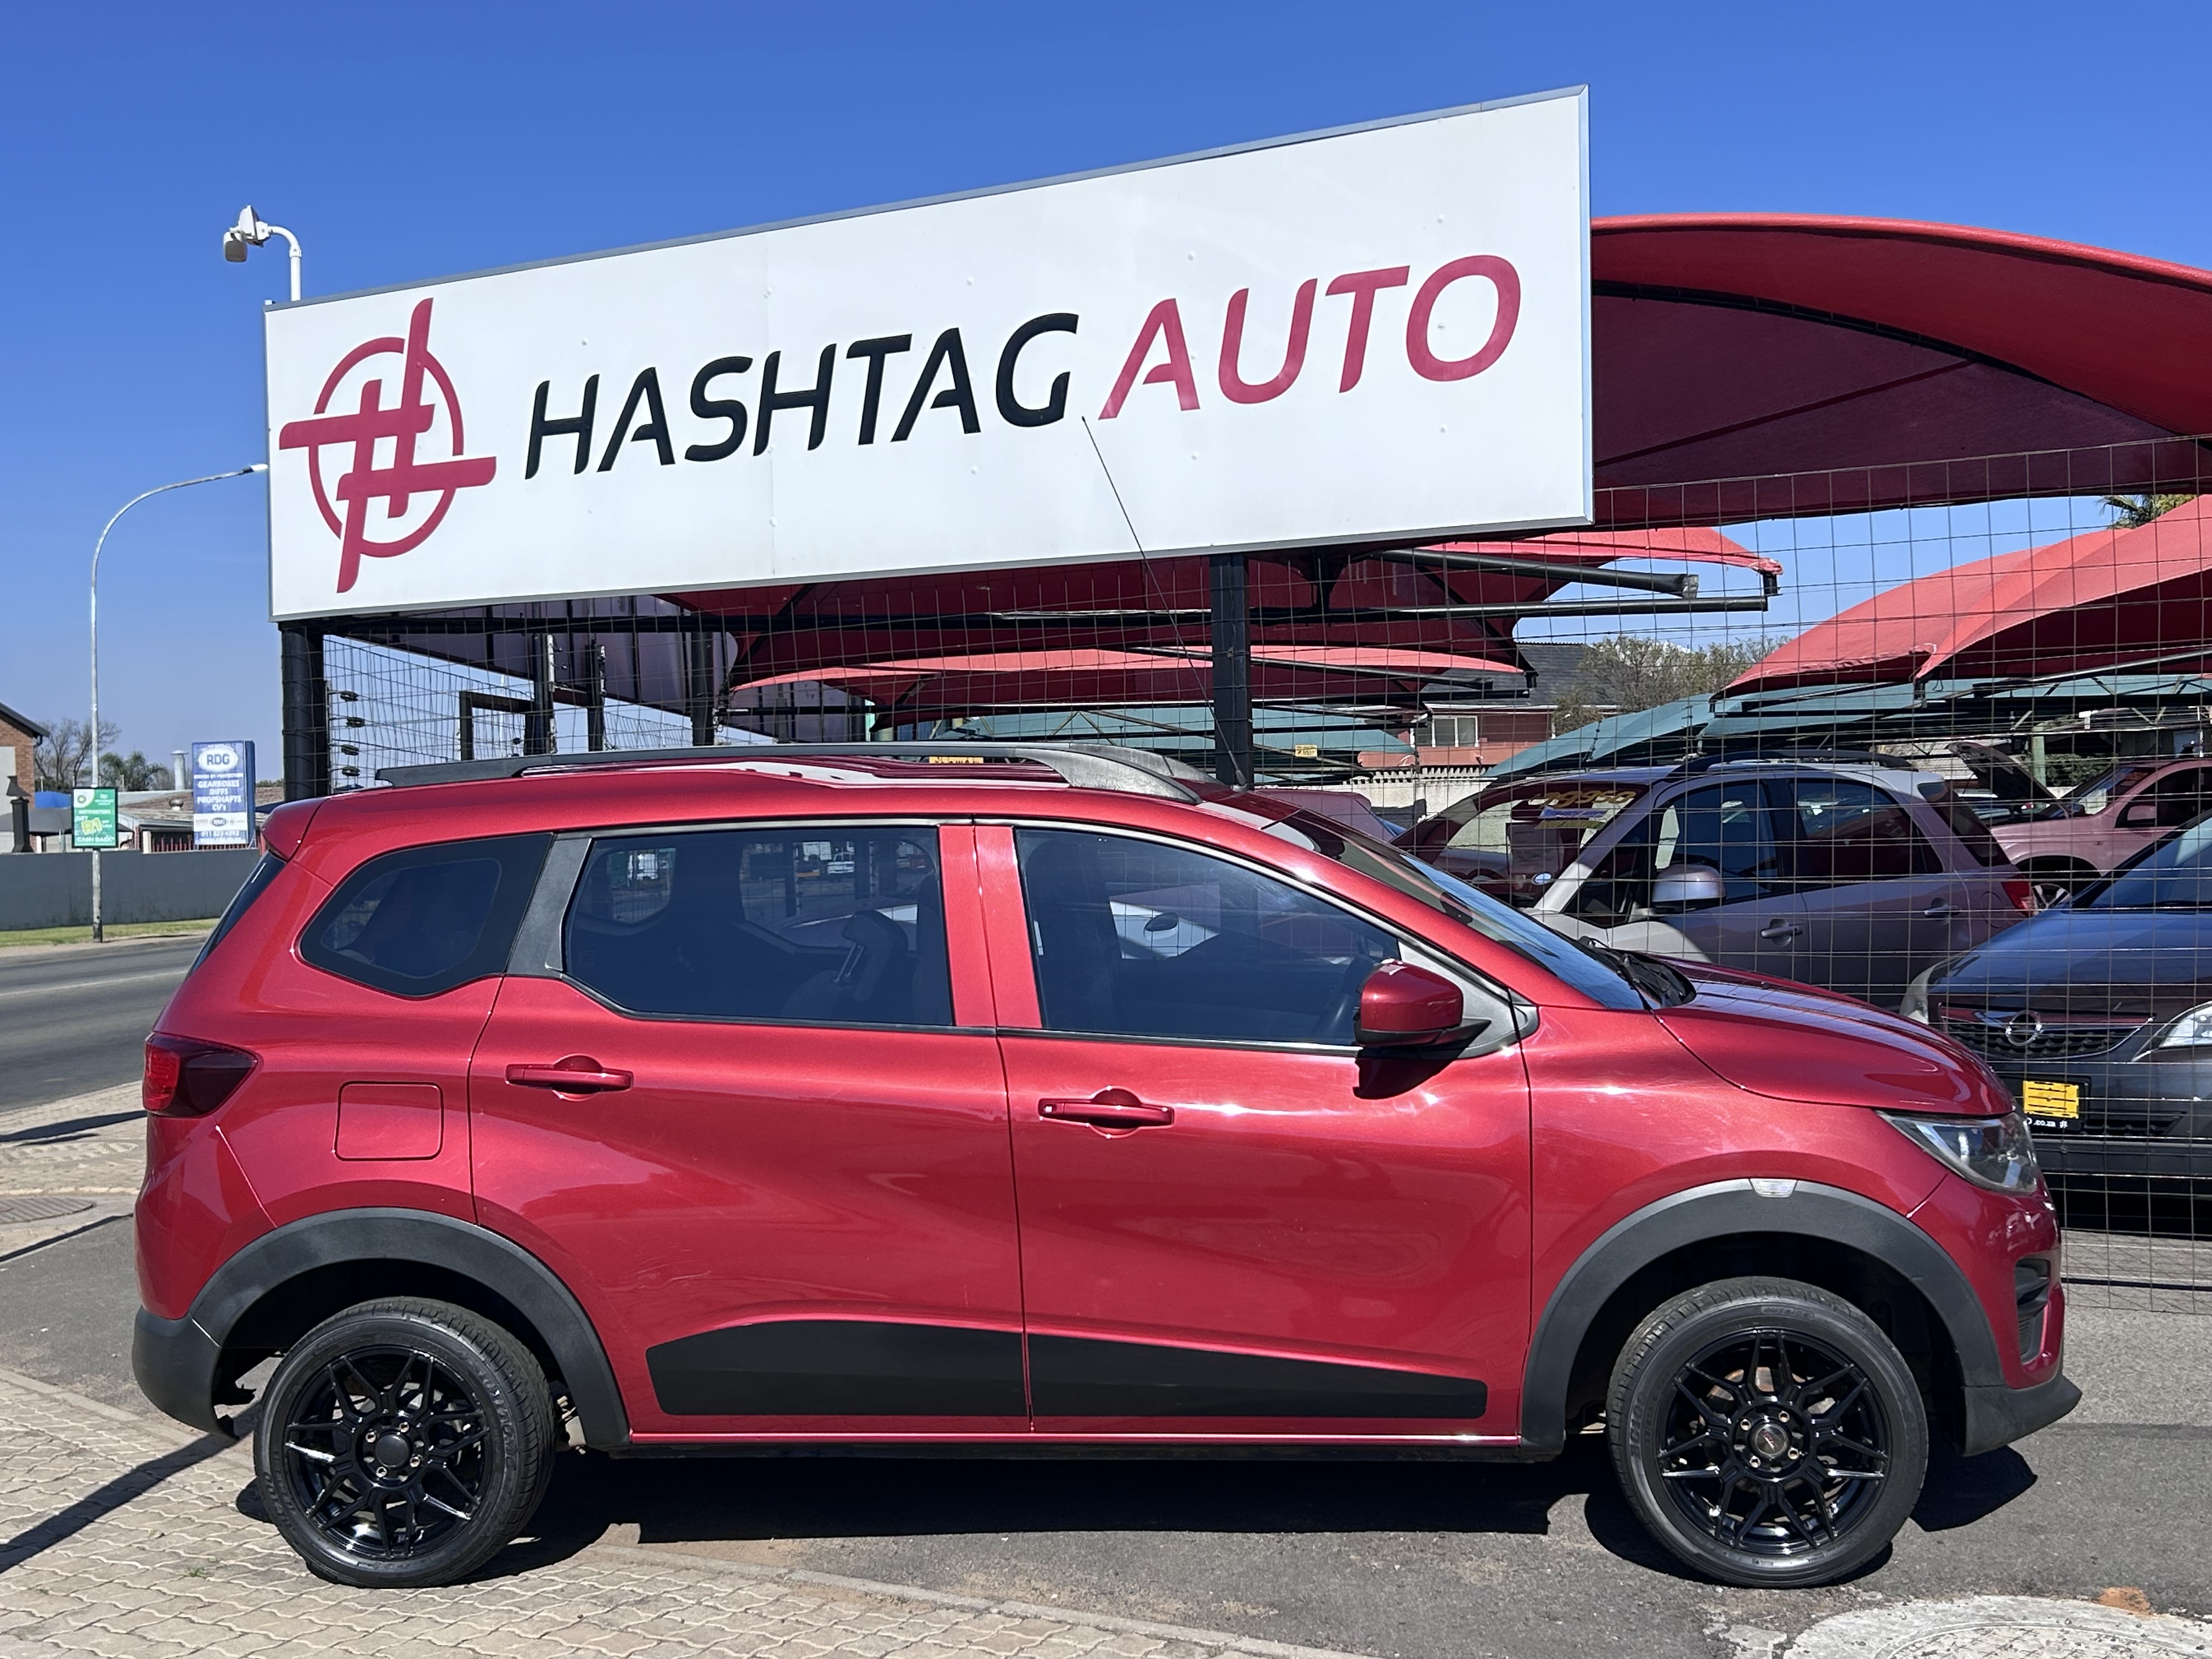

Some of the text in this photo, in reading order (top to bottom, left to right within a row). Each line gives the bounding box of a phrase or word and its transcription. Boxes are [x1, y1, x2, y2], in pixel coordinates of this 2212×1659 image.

[525, 255, 1521, 480] HASHTAG AUTO
[207, 754, 230, 765] RDG
[198, 780, 240, 788] GEARBOXES
[197, 795, 242, 804] PROPSHAFTS
